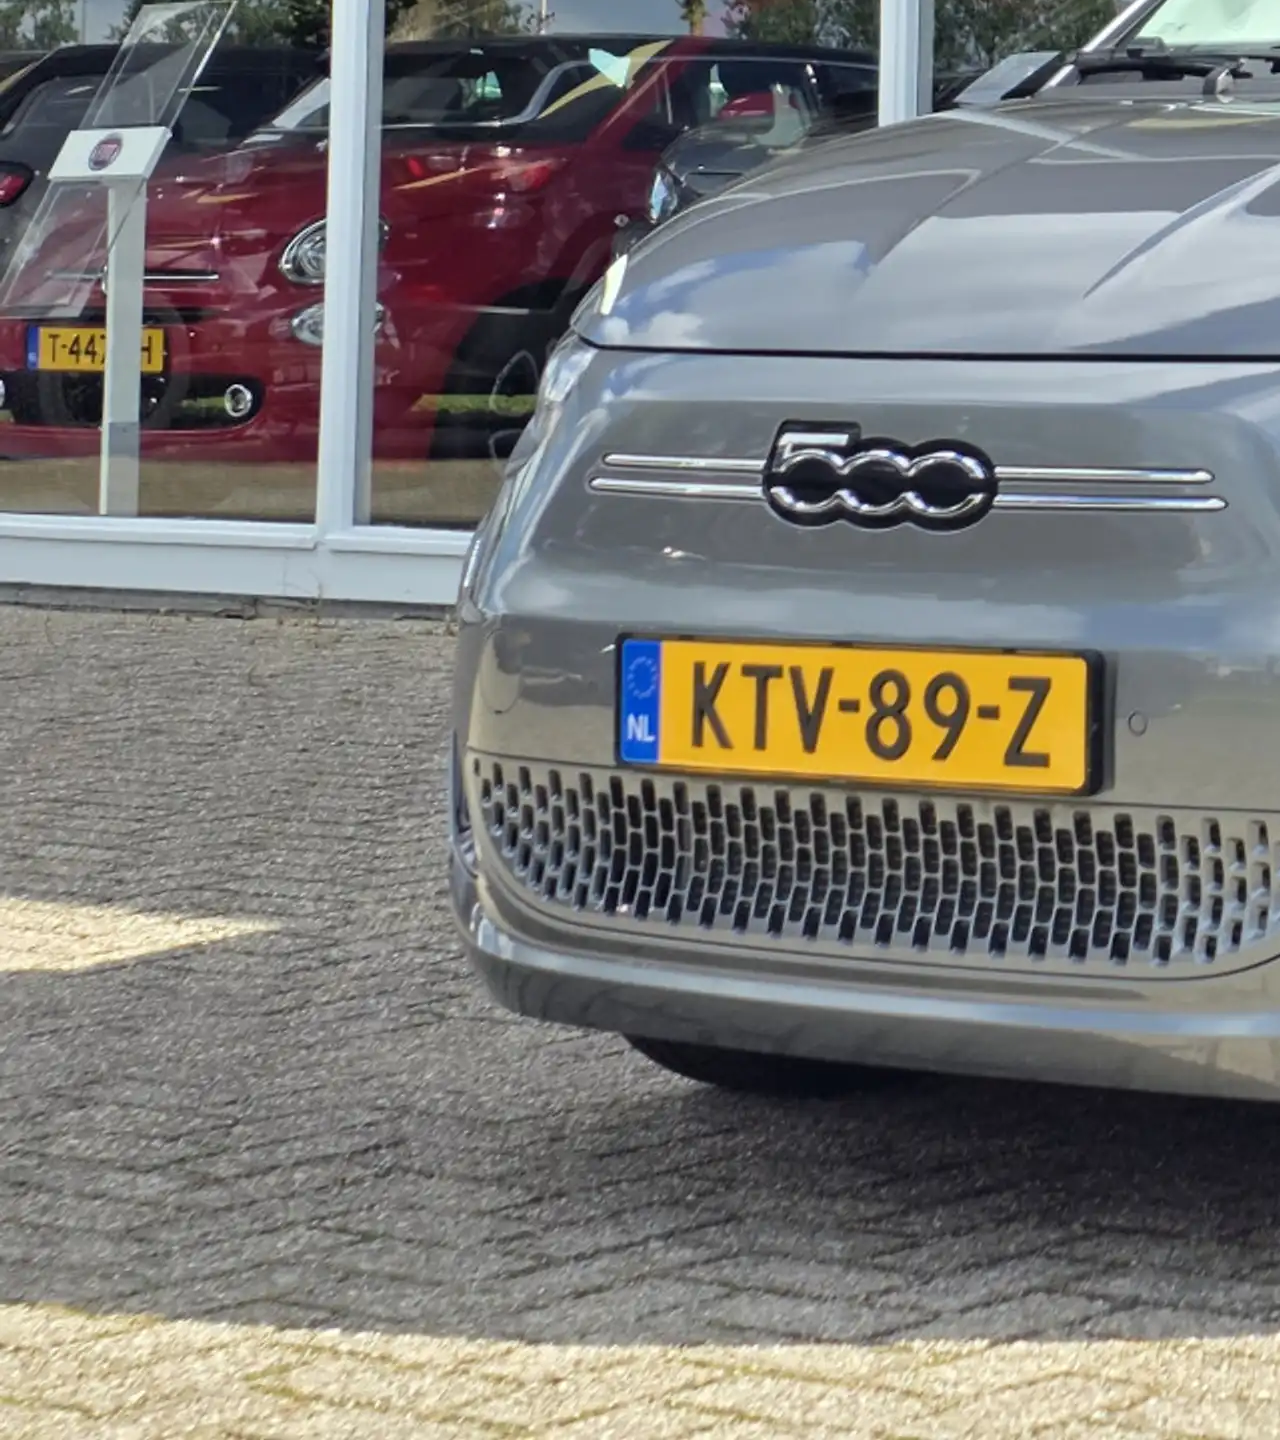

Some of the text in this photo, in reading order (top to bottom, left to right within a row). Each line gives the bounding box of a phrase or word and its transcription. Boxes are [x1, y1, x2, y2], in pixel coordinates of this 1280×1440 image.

[767, 427, 990, 523] 500
[627, 661, 1053, 768] NL KTV-89-Z
